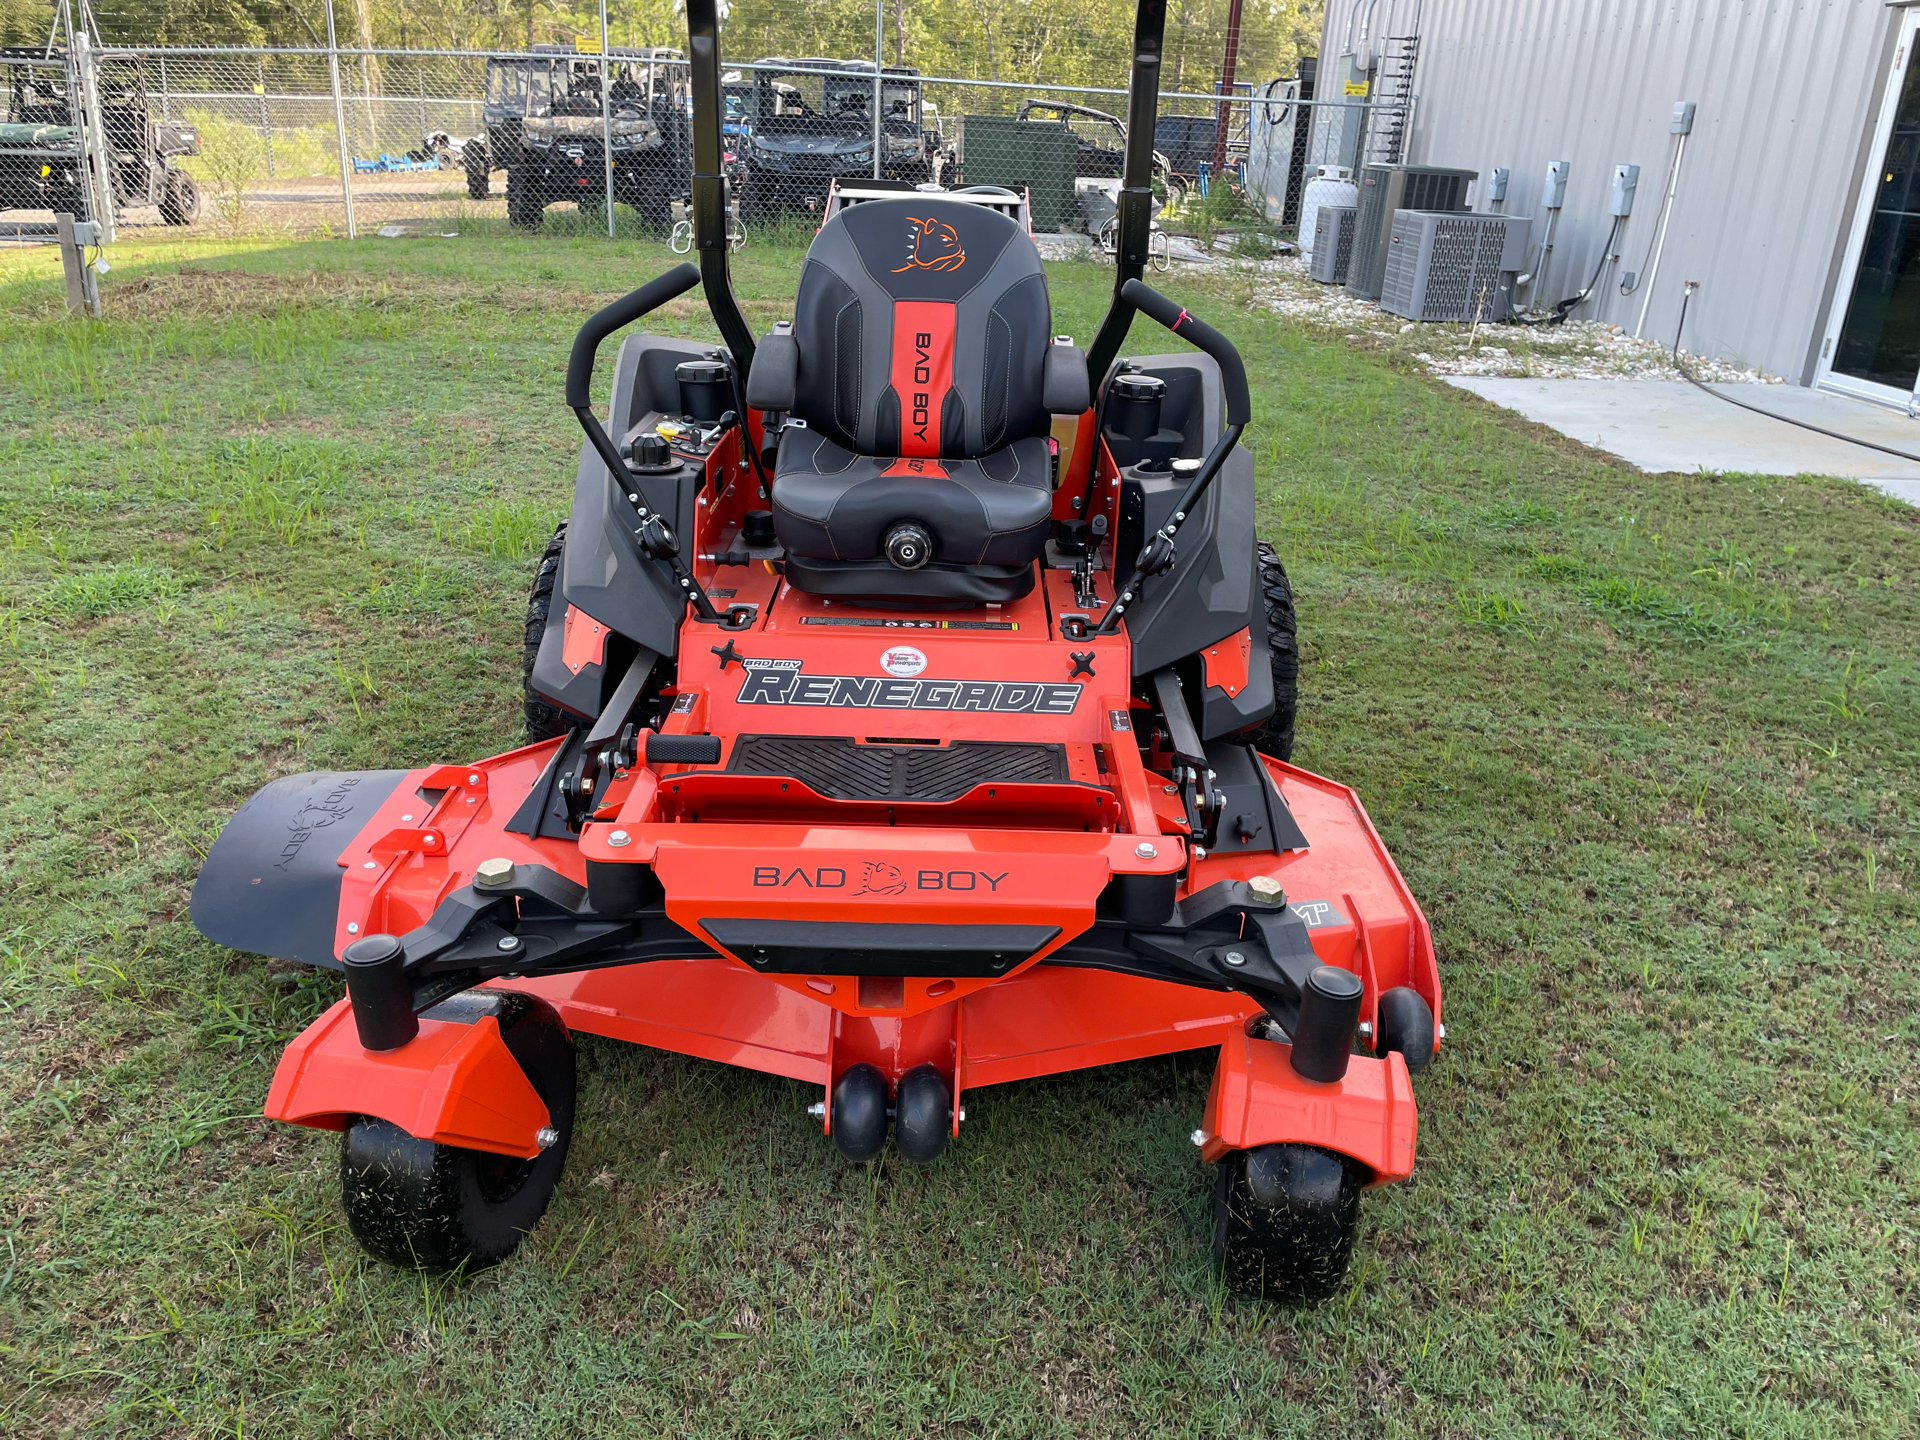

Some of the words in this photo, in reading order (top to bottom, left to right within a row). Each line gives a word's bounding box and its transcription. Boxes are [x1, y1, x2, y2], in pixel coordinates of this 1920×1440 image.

[914, 332, 931, 384] BAD
[912, 392, 929, 444] BOY
[774, 660, 800, 668] BOY
[736, 668, 1083, 714] RENEGADE
[324, 778, 361, 804] BAD
[273, 831, 312, 873] BOY
[753, 866, 846, 888] BAD
[917, 869, 1009, 892] BOY
